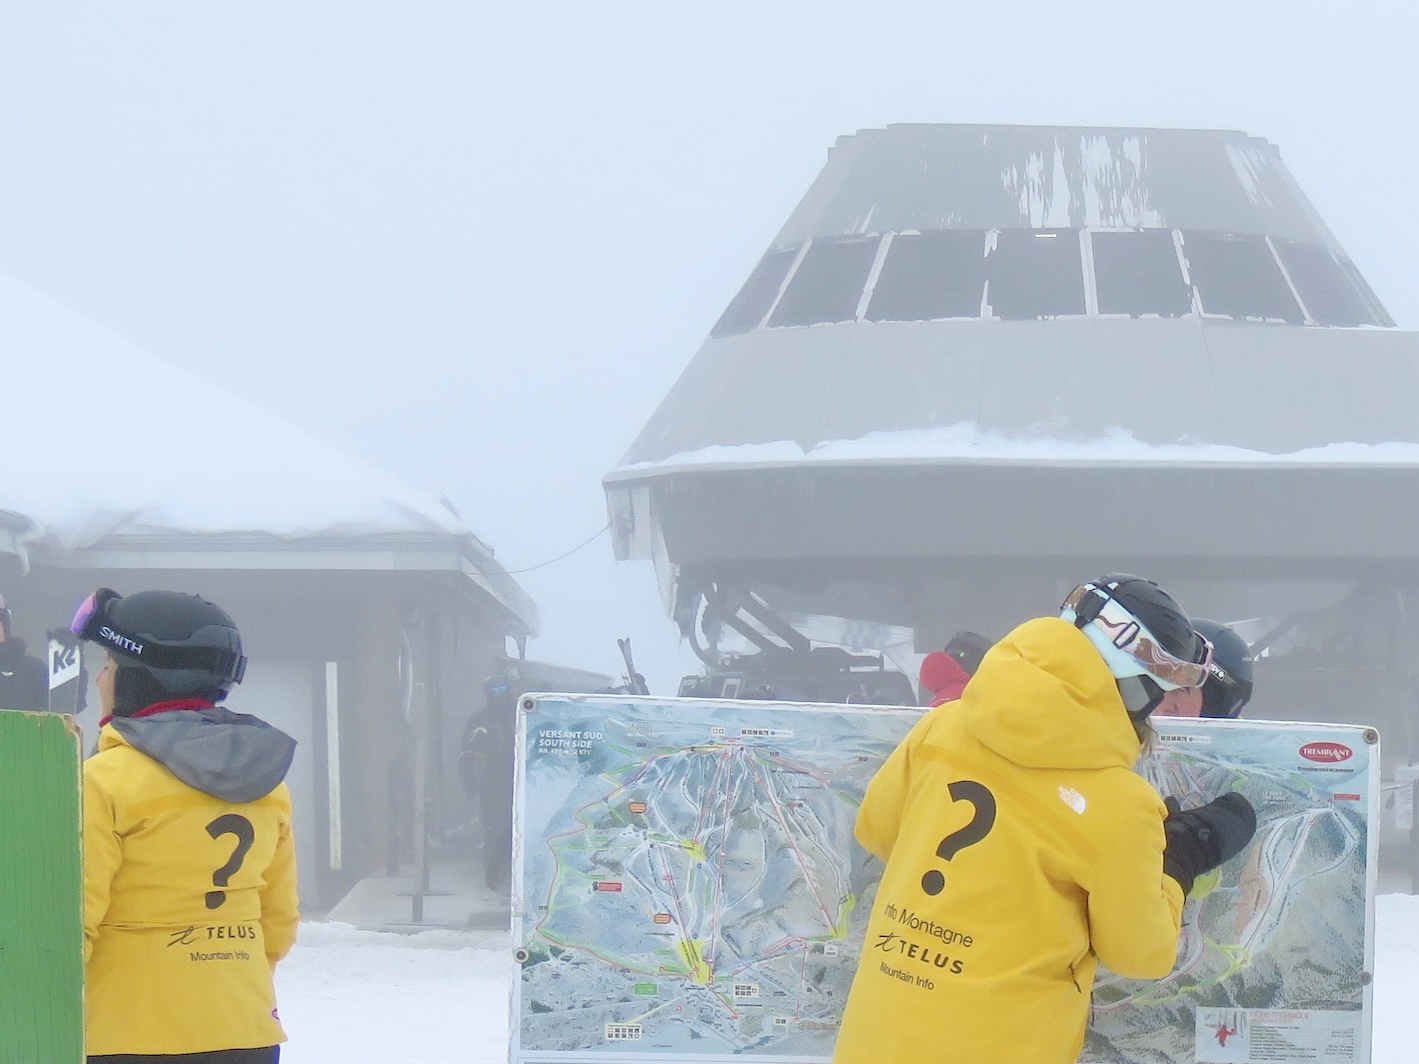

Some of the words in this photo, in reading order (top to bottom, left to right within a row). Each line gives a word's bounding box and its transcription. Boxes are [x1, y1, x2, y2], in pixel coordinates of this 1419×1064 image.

[99, 626, 144, 654] SMITH
[539, 730, 582, 739] VERSANT
[584, 731, 603, 740] SUD
[539, 739, 571, 748] SOUTH
[571, 740, 592, 748] SIDE
[1302, 748, 1350, 761] TREMBLANT
[207, 925, 256, 939] TELUS
[898, 908, 974, 947] Montagne
[190, 951, 234, 961] Mountain
[235, 951, 250, 961] Info
[900, 940, 964, 974] TELUS
[879, 961, 914, 984] Mountain
[916, 975, 935, 991] Info
